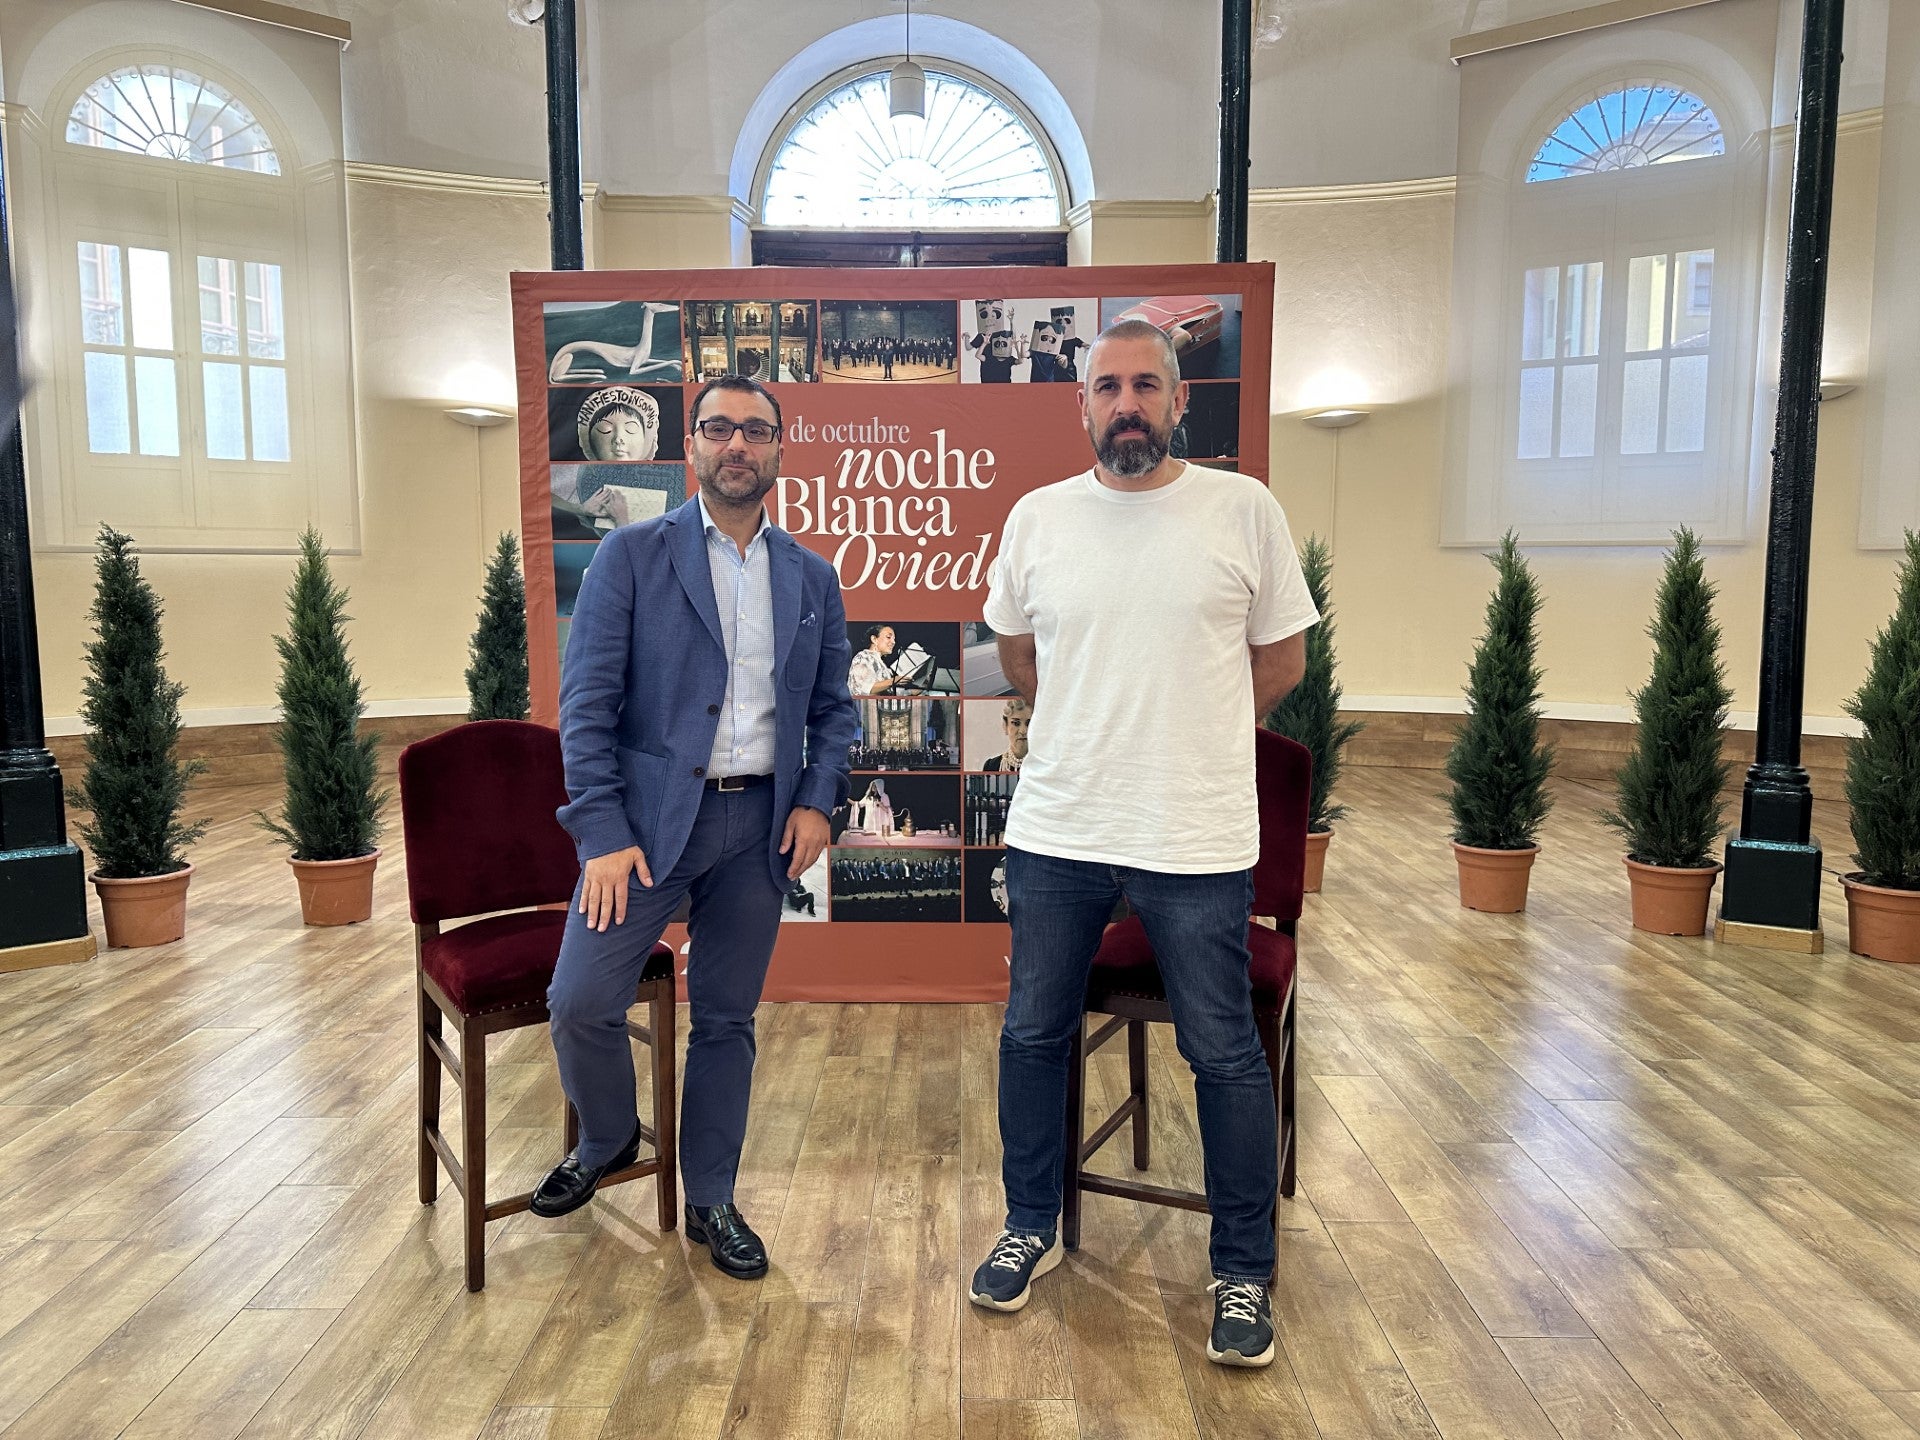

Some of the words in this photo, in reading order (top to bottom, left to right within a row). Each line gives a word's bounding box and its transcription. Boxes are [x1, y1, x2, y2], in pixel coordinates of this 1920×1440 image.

[789, 415, 817, 443] de
[821, 416, 911, 444] octubre
[834, 428, 997, 490] noche
[776, 475, 958, 537] Blanca
